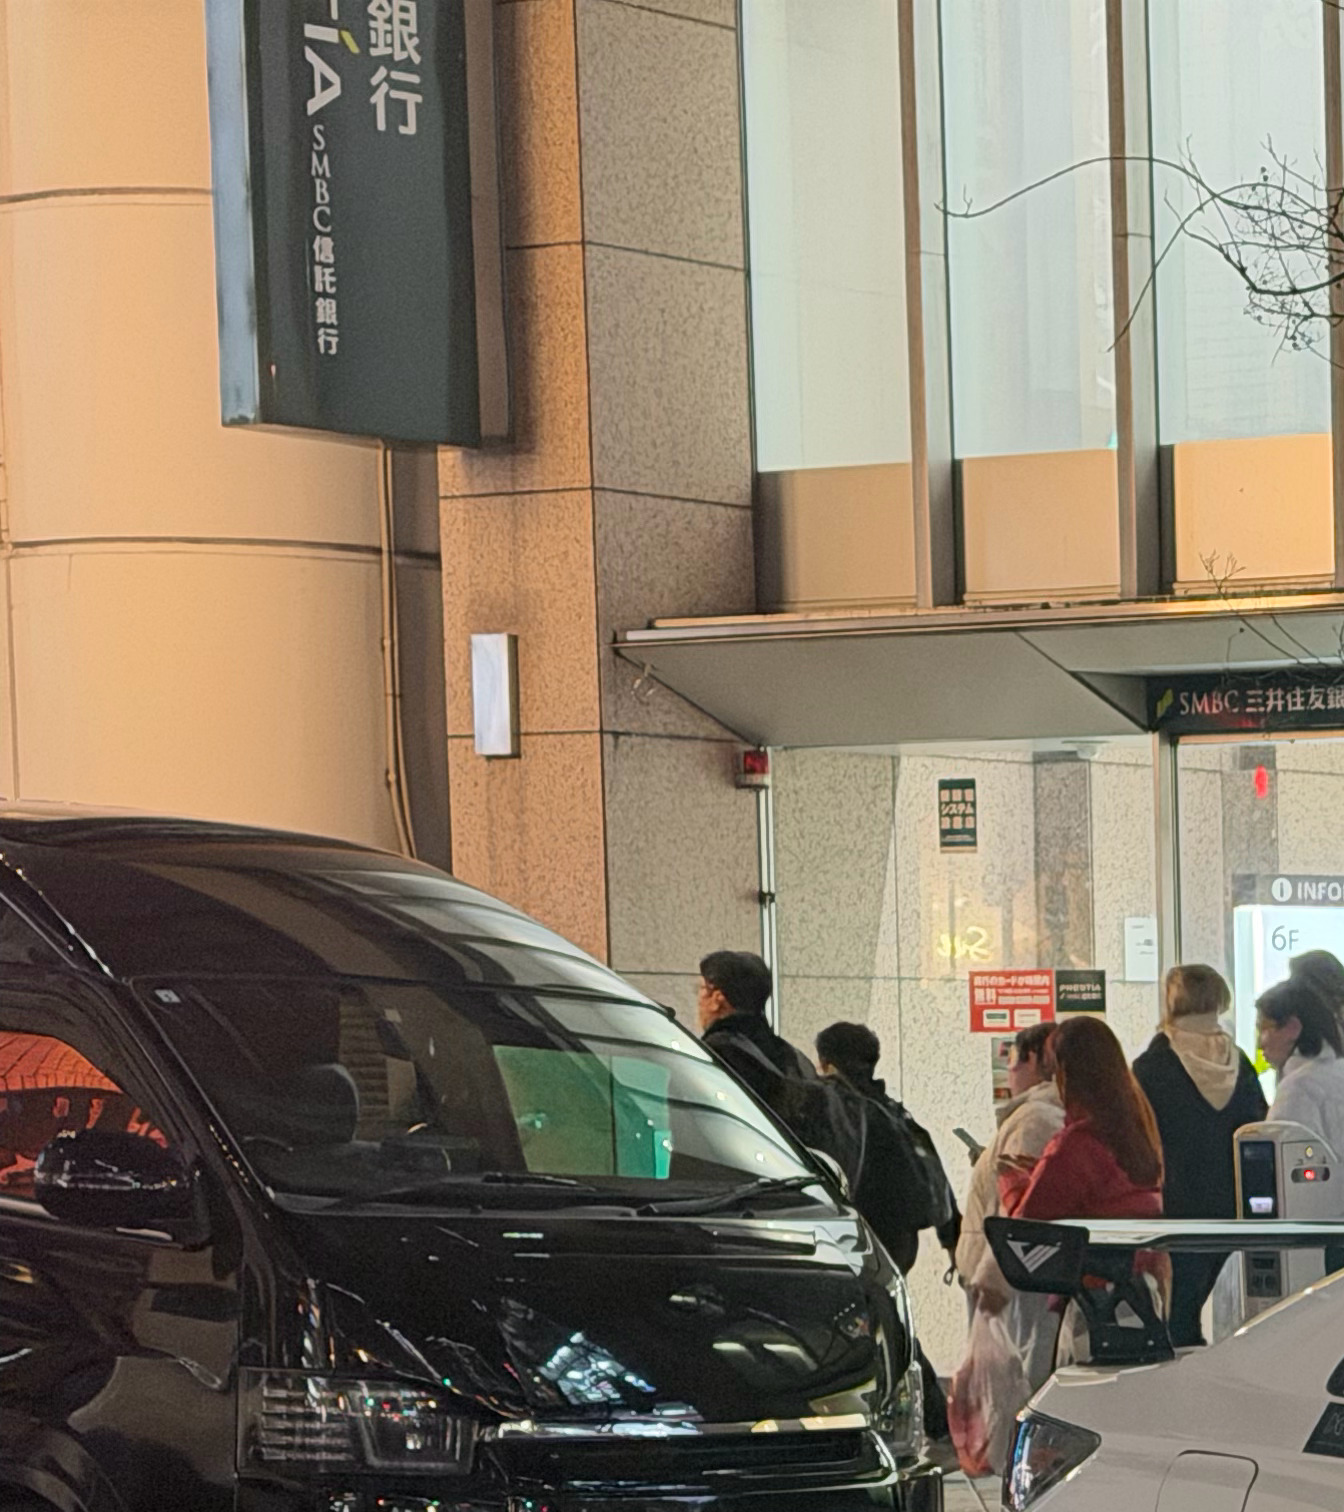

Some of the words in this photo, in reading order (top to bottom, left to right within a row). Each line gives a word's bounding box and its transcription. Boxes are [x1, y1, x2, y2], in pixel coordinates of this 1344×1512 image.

[366, 0, 423, 135] 銀行
[311, 124, 339, 355] SMBC信託銀行
[1180, 690, 1240, 716] SMBC
[1271, 925, 1300, 951] 6F
